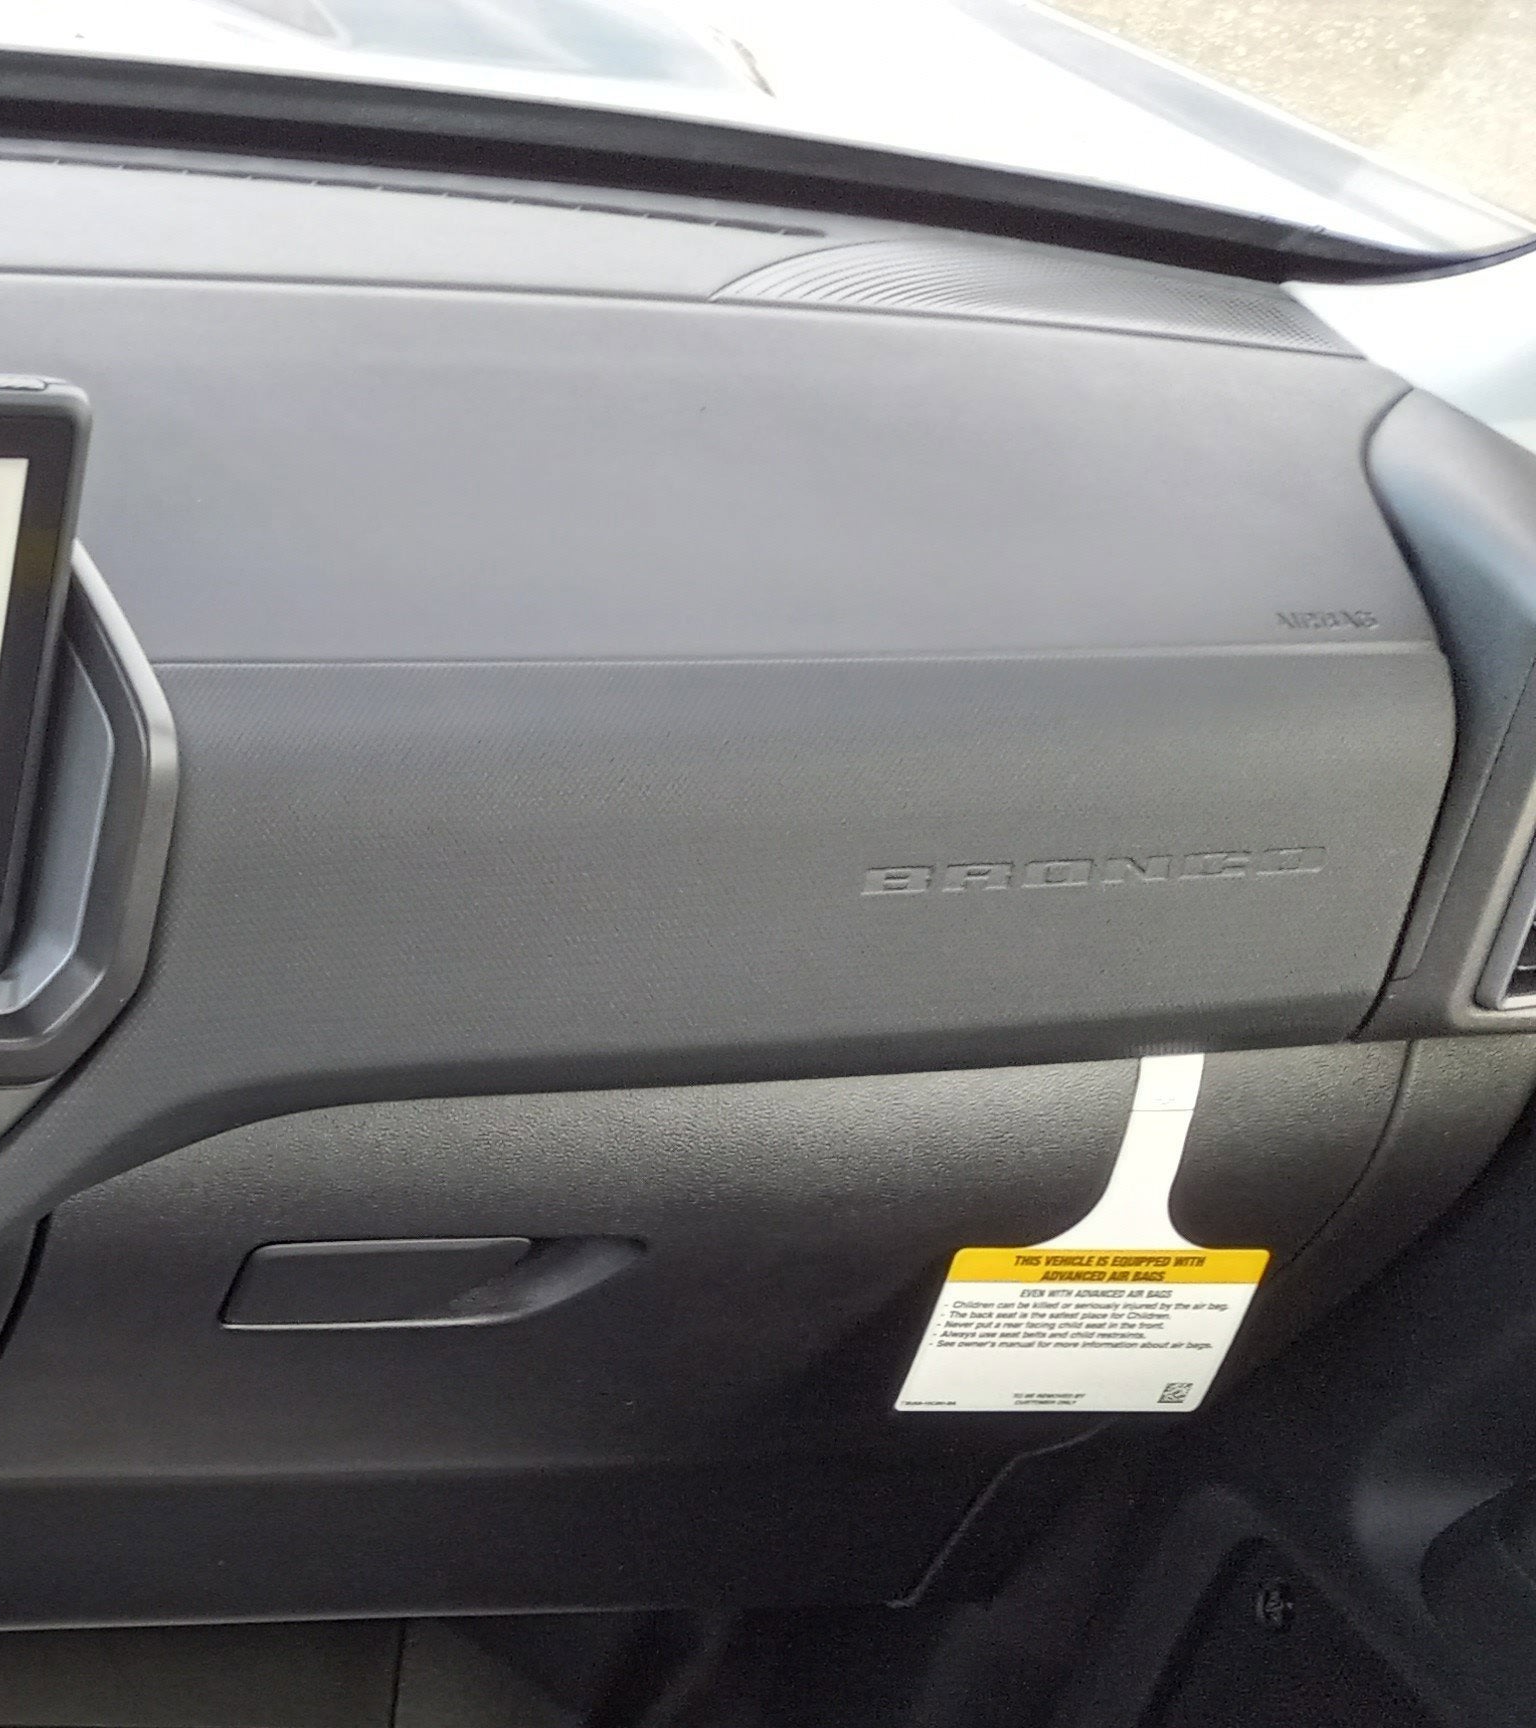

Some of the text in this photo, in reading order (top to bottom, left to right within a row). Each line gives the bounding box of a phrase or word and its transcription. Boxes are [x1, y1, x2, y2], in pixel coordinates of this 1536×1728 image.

[1015, 1256, 1206, 1267] THIS VEHICLE IS EQUIPPED WITH
[1040, 1271, 1165, 1281] ADVANCED AIR BAGS
[1020, 1289, 1173, 1298] EVEN WITH ADVANCED AIR BAGS
